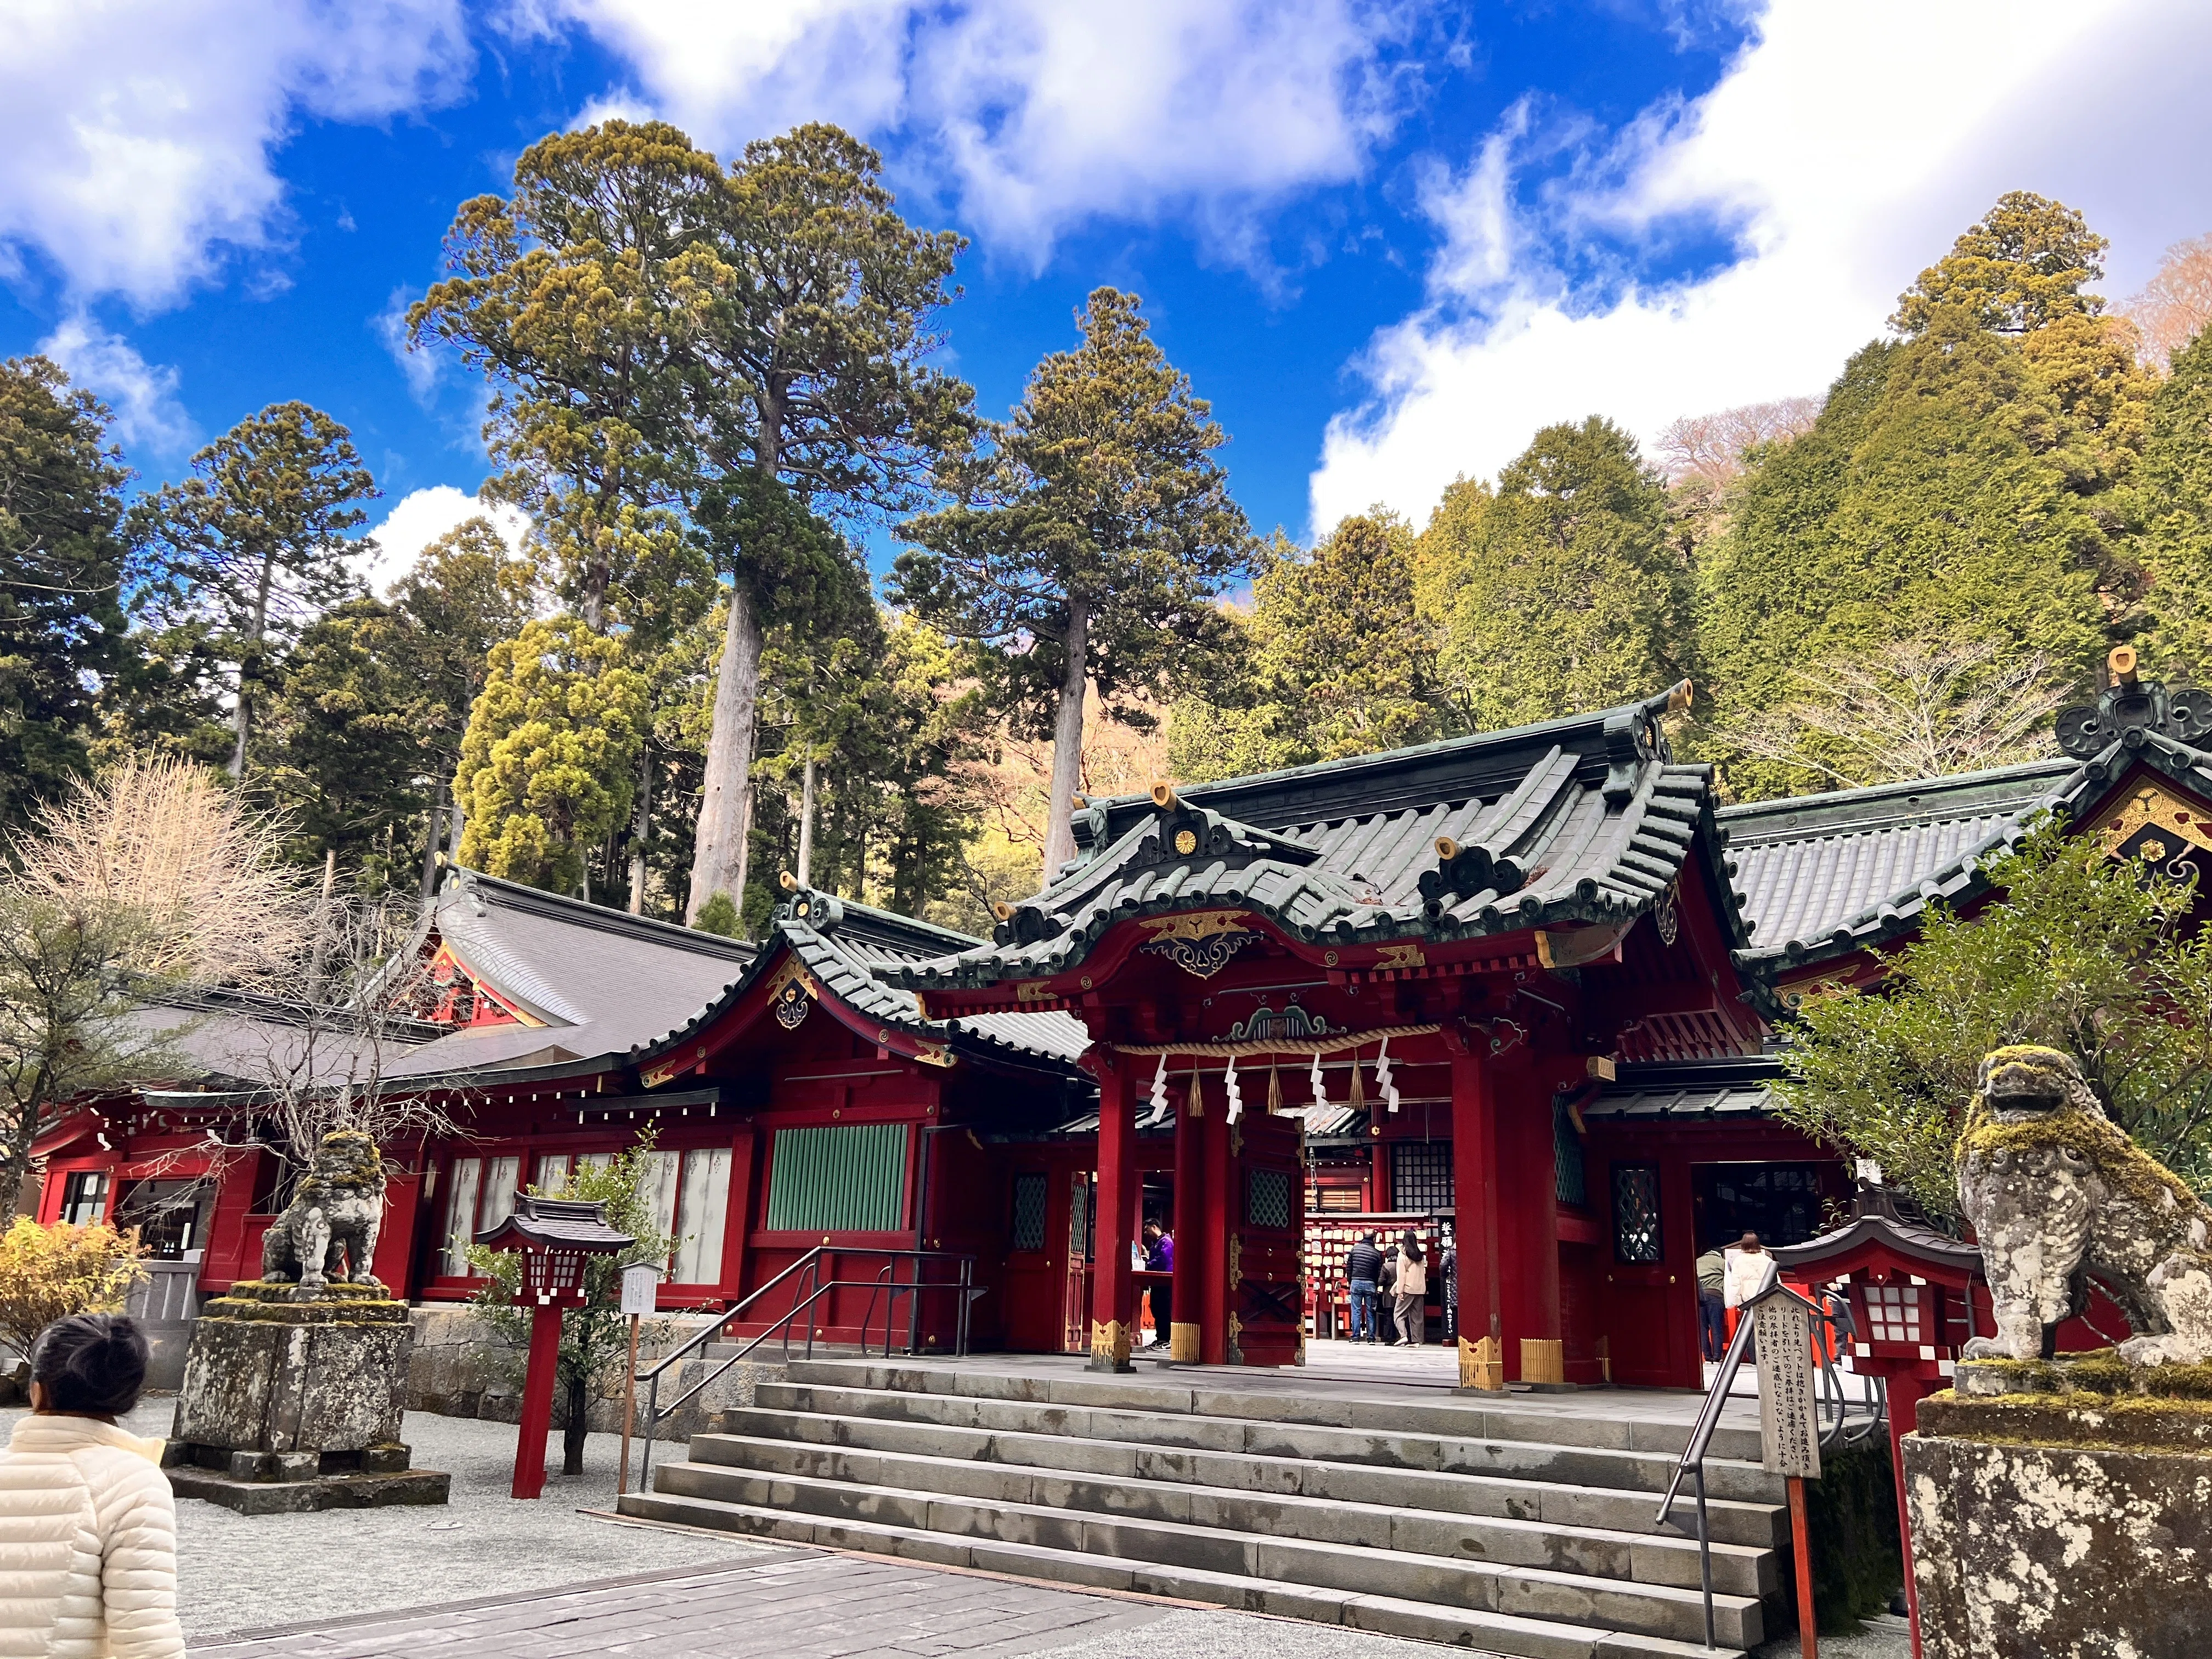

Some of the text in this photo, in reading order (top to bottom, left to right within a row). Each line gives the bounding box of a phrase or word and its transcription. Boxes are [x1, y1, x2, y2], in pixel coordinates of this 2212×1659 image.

[1757, 1305, 1769, 1364] ご注意願います。
